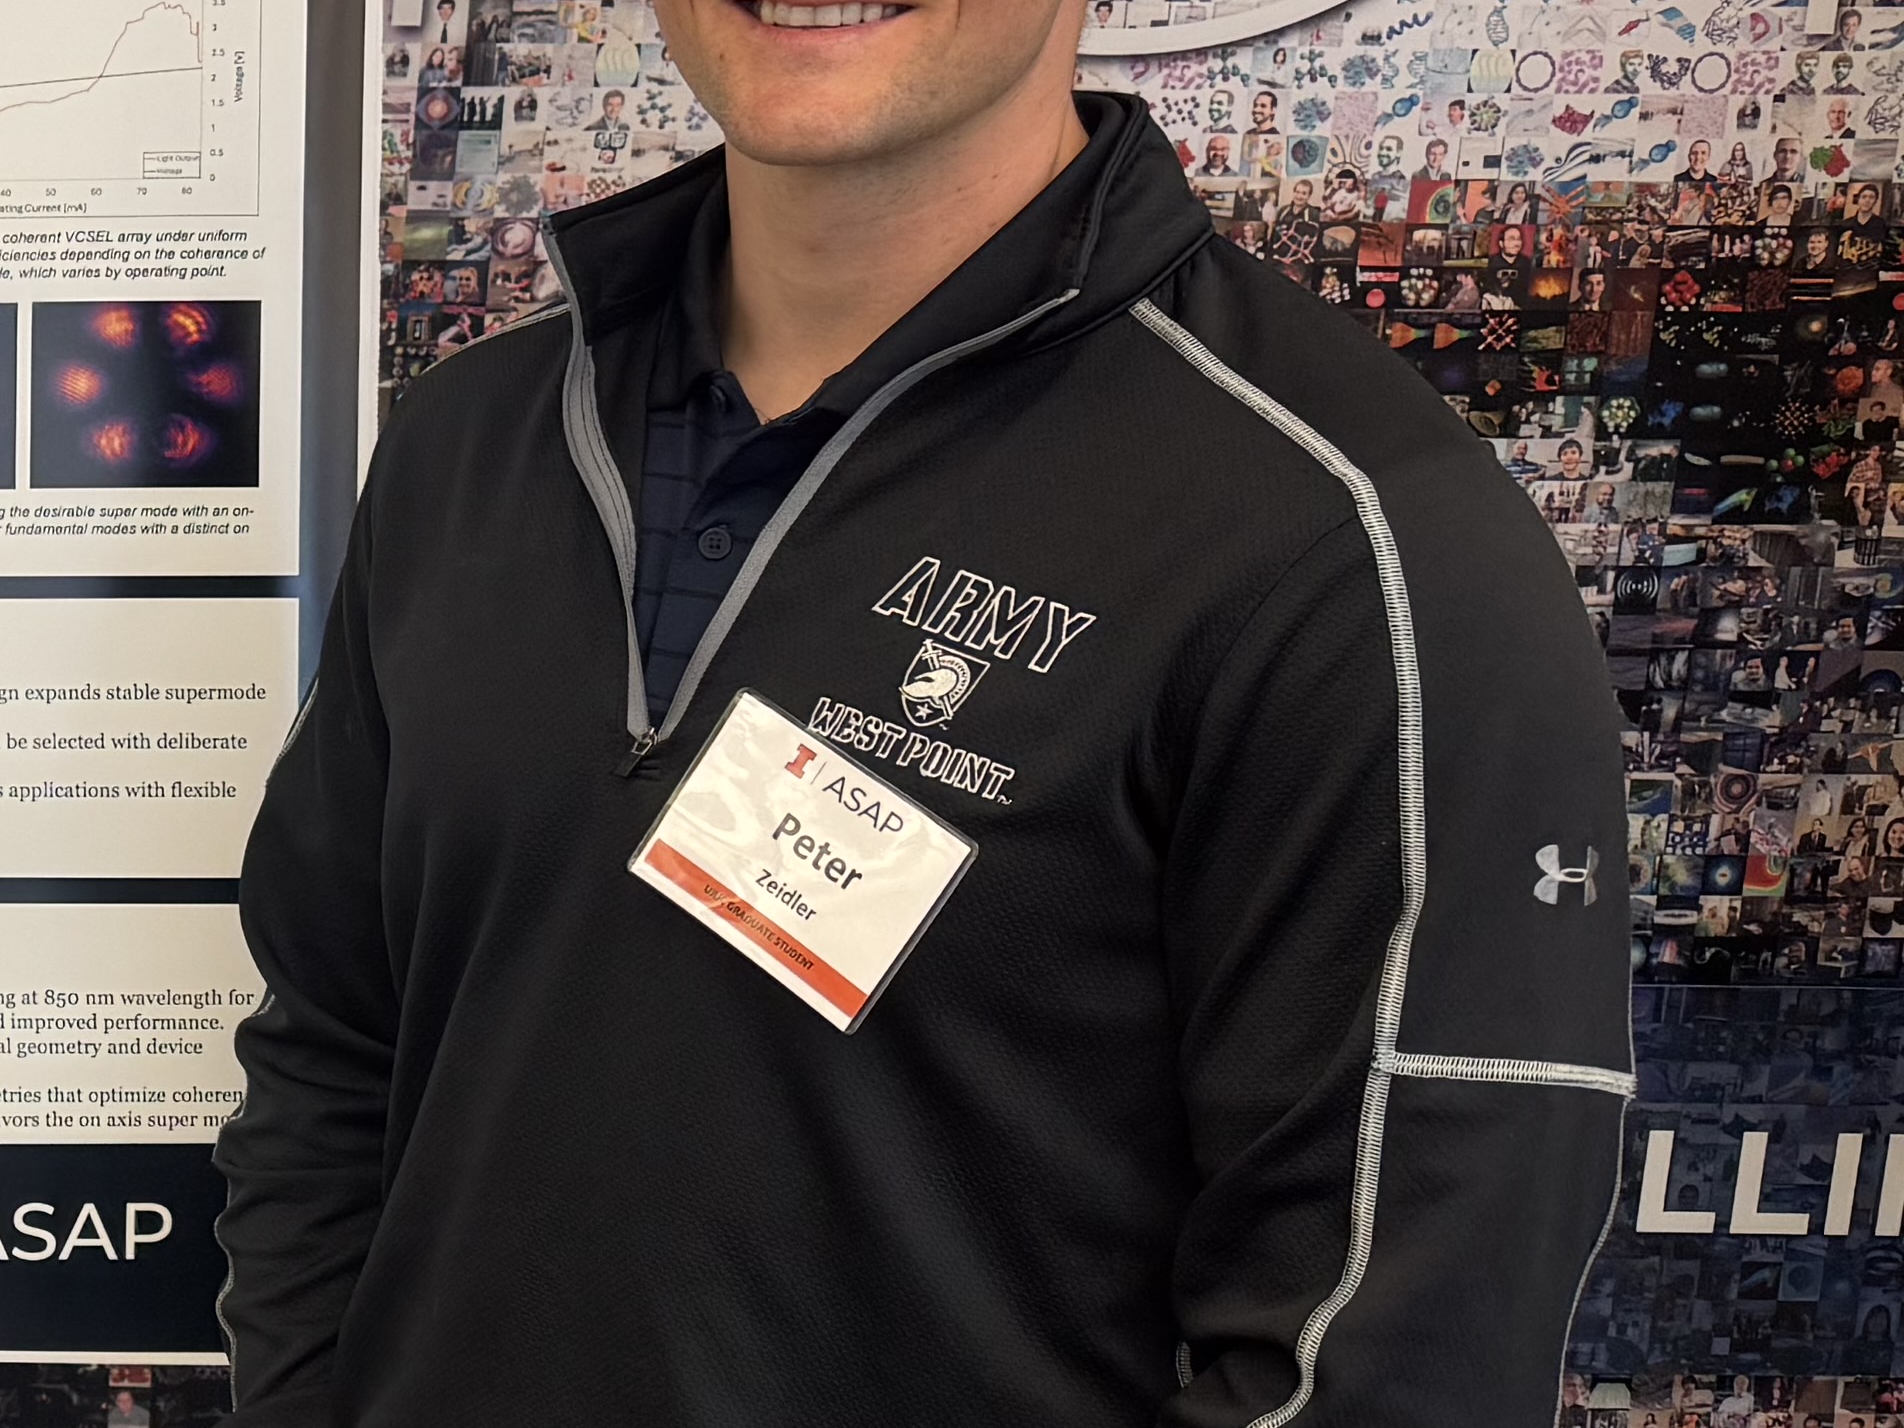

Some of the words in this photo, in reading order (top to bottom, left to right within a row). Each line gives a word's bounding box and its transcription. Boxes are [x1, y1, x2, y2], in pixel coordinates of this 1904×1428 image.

[871, 556, 1097, 673] ARMY
[6, 731, 28, 751] be
[32, 731, 106, 751] selected
[110, 731, 152, 751] with
[156, 731, 248, 751] deliberate
[808, 696, 906, 759] WEST
[895, 733, 1015, 801] POINT
[822, 775, 905, 835] ASAP
[771, 812, 863, 891] Peter
[755, 868, 817, 921] Zeidler
[774, 936, 815, 971] STUDENT
[20, 989, 39, 1007] at
[43, 988, 80, 1010] 850
[85, 992, 115, 1007] nm
[120, 987, 223, 1011] wavelength
[228, 987, 256, 1006] for
